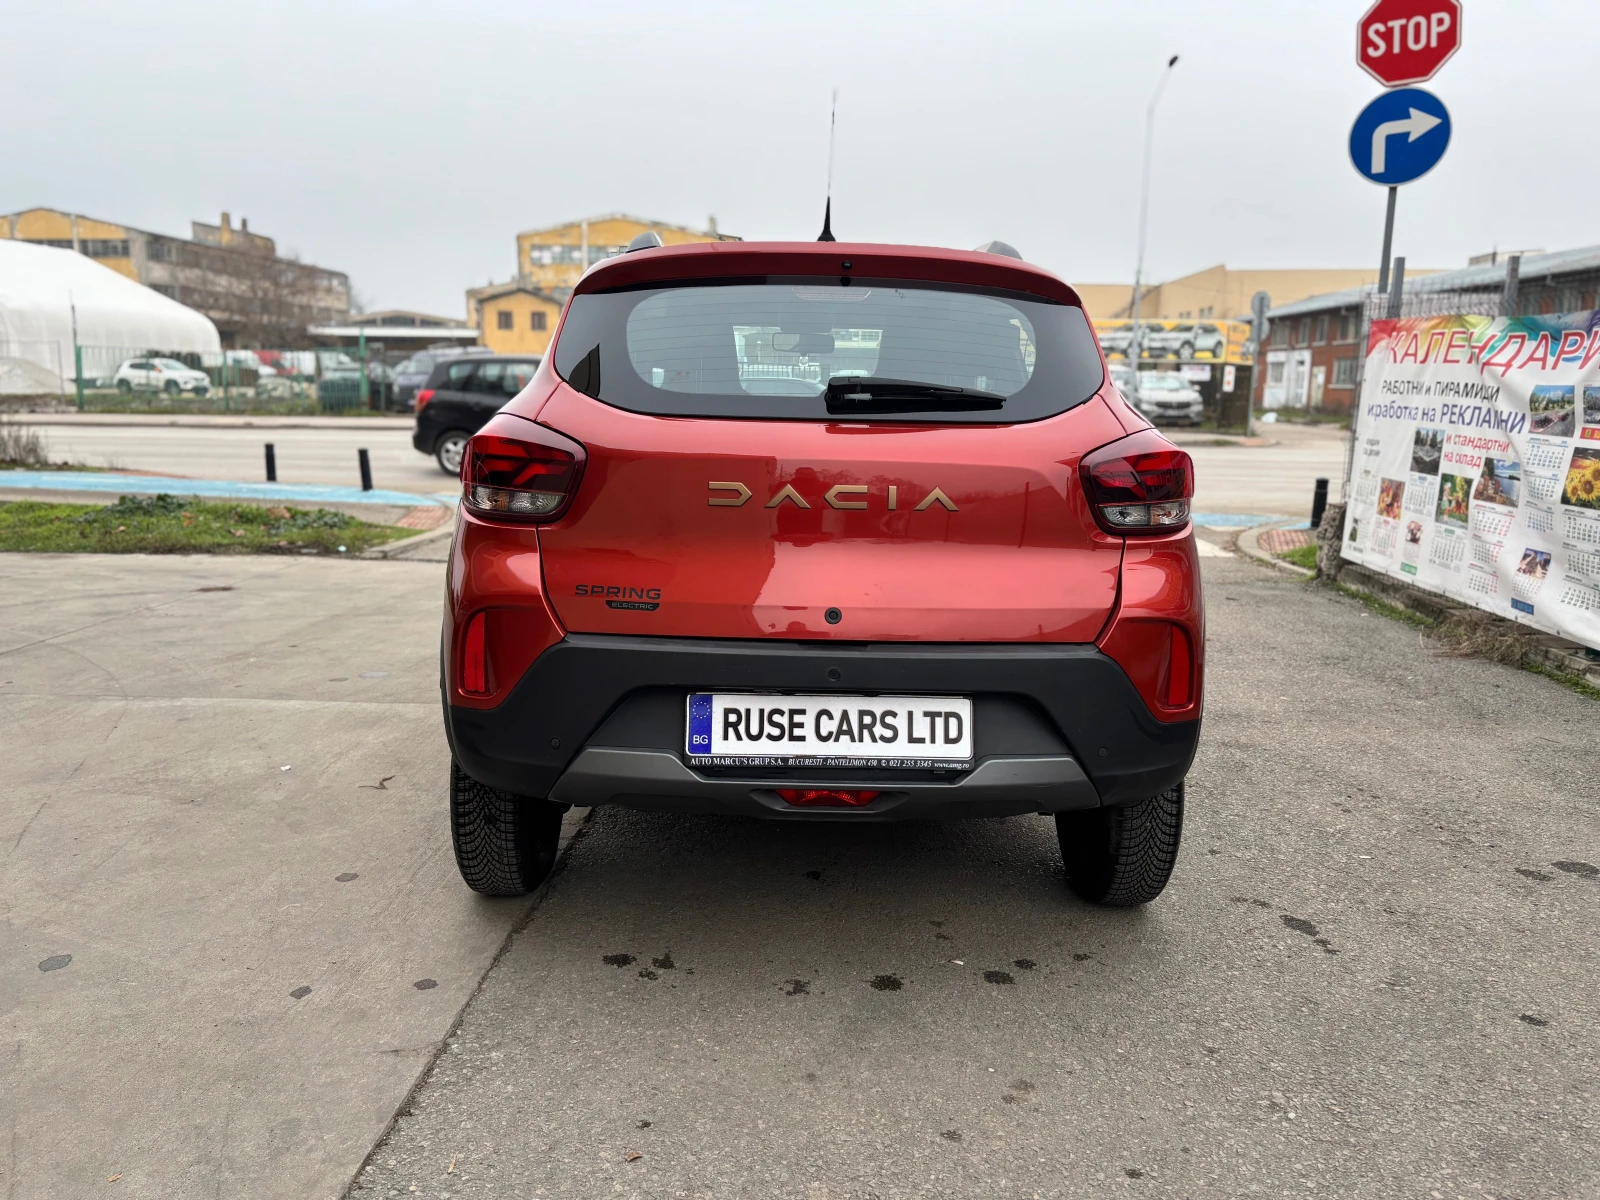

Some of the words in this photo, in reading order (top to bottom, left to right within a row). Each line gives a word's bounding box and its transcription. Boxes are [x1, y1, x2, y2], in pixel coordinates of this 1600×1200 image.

[1366, 11, 1451, 58] STOP
[1381, 379, 1424, 396] РАБОТНИ
[1421, 407, 1436, 422] на
[1445, 434, 1452, 444] и
[1453, 434, 1510, 453] стандартни
[1443, 451, 1454, 462] на
[707, 481, 960, 512] DACIA
[574, 583, 662, 600] SPRING
[611, 601, 654, 610] ELECTRIC
[722, 707, 807, 742] RUSE
[814, 708, 899, 744] CARS
[907, 710, 964, 745] LTD
[692, 735, 709, 745] BG
[690, 757, 712, 765] AUTO
[748, 757, 770, 766] GRUP
[787, 758, 823, 766] BUCURESTI
[826, 758, 867, 767] PANTELIMON
[867, 759, 878, 767] 450
[915, 760, 932, 768] 3345
